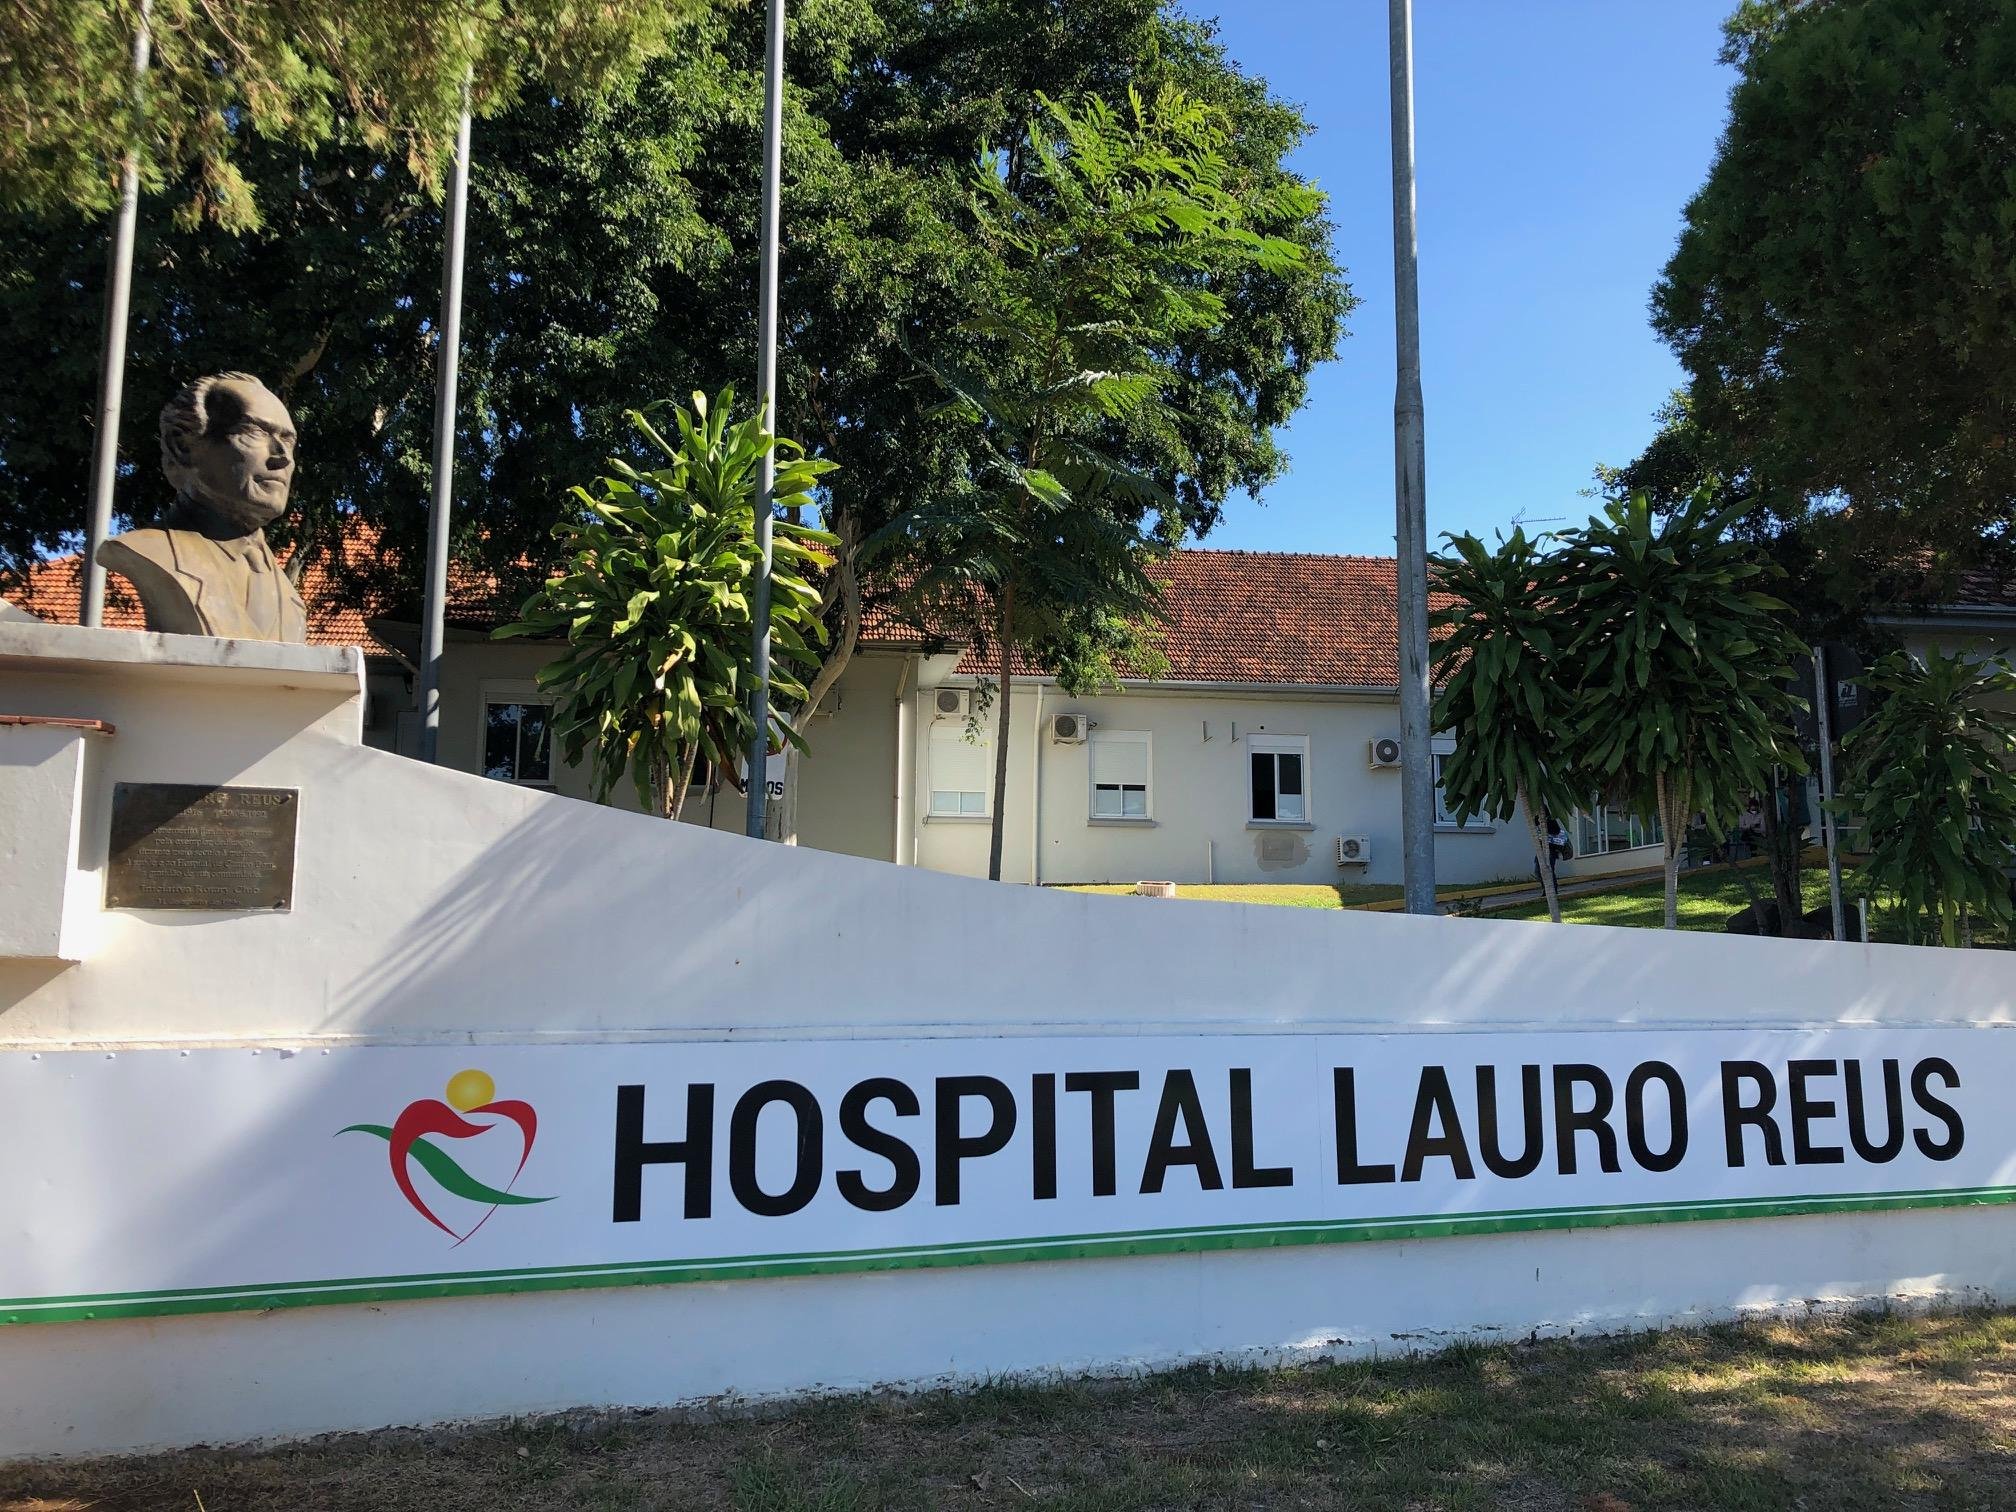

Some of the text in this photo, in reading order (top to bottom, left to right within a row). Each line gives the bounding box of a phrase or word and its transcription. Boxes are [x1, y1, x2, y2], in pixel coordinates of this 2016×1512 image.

[613, 1057, 1965, 1223] HOSPITAL LAURO REUS
